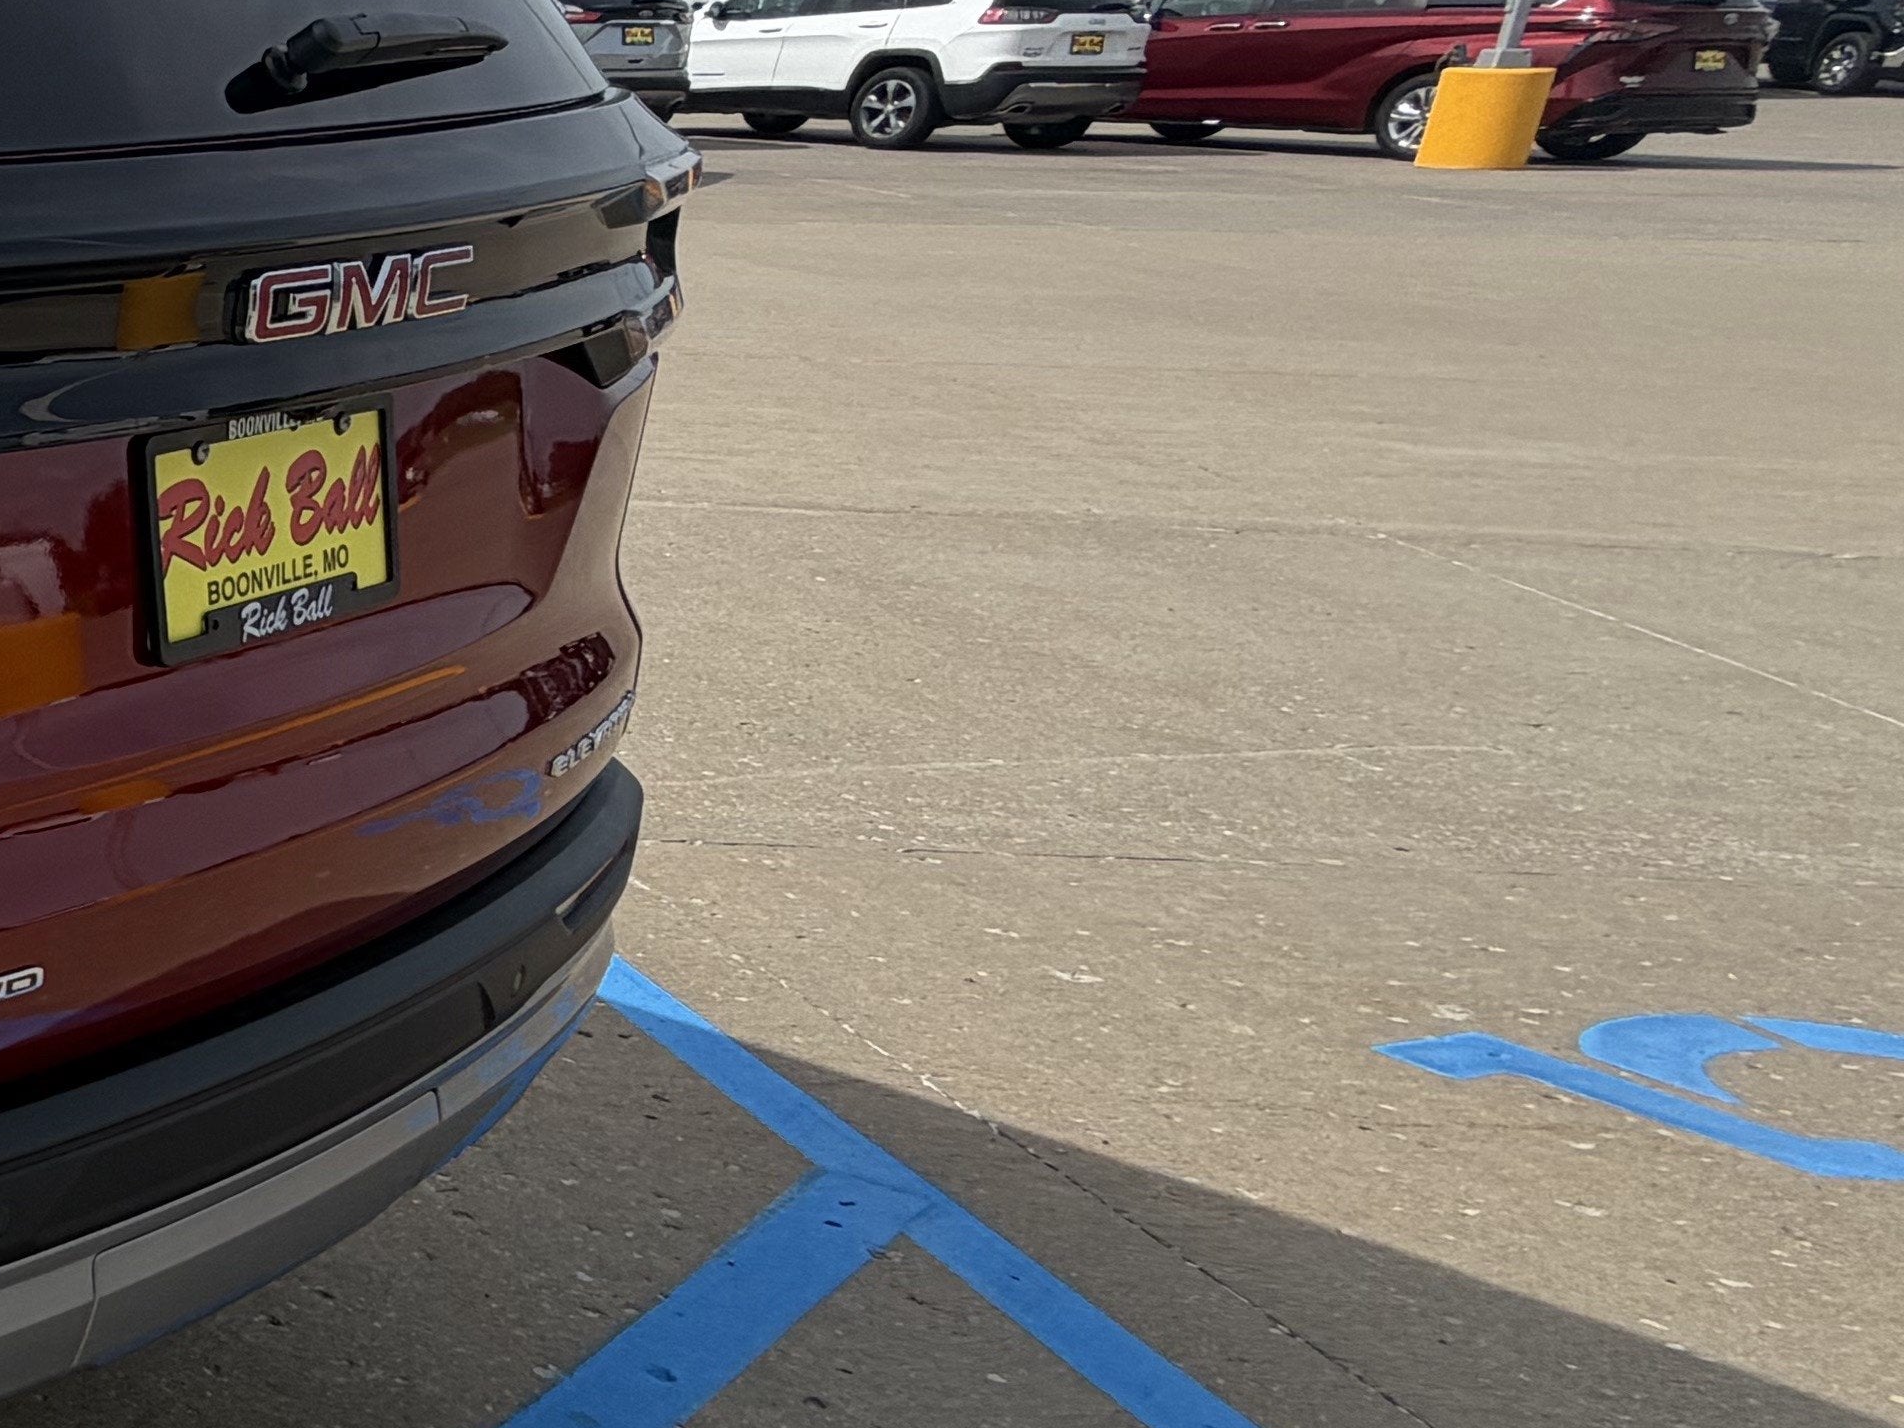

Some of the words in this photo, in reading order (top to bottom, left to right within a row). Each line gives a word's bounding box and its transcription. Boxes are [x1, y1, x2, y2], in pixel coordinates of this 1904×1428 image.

[245, 245, 474, 343] GMC
[158, 465, 276, 579] Rick
[286, 442, 382, 546] Ball
[207, 553, 318, 606] BOONVILLE,
[322, 544, 350, 573] MO
[241, 593, 288, 643] Rick
[291, 584, 334, 625] Ball
